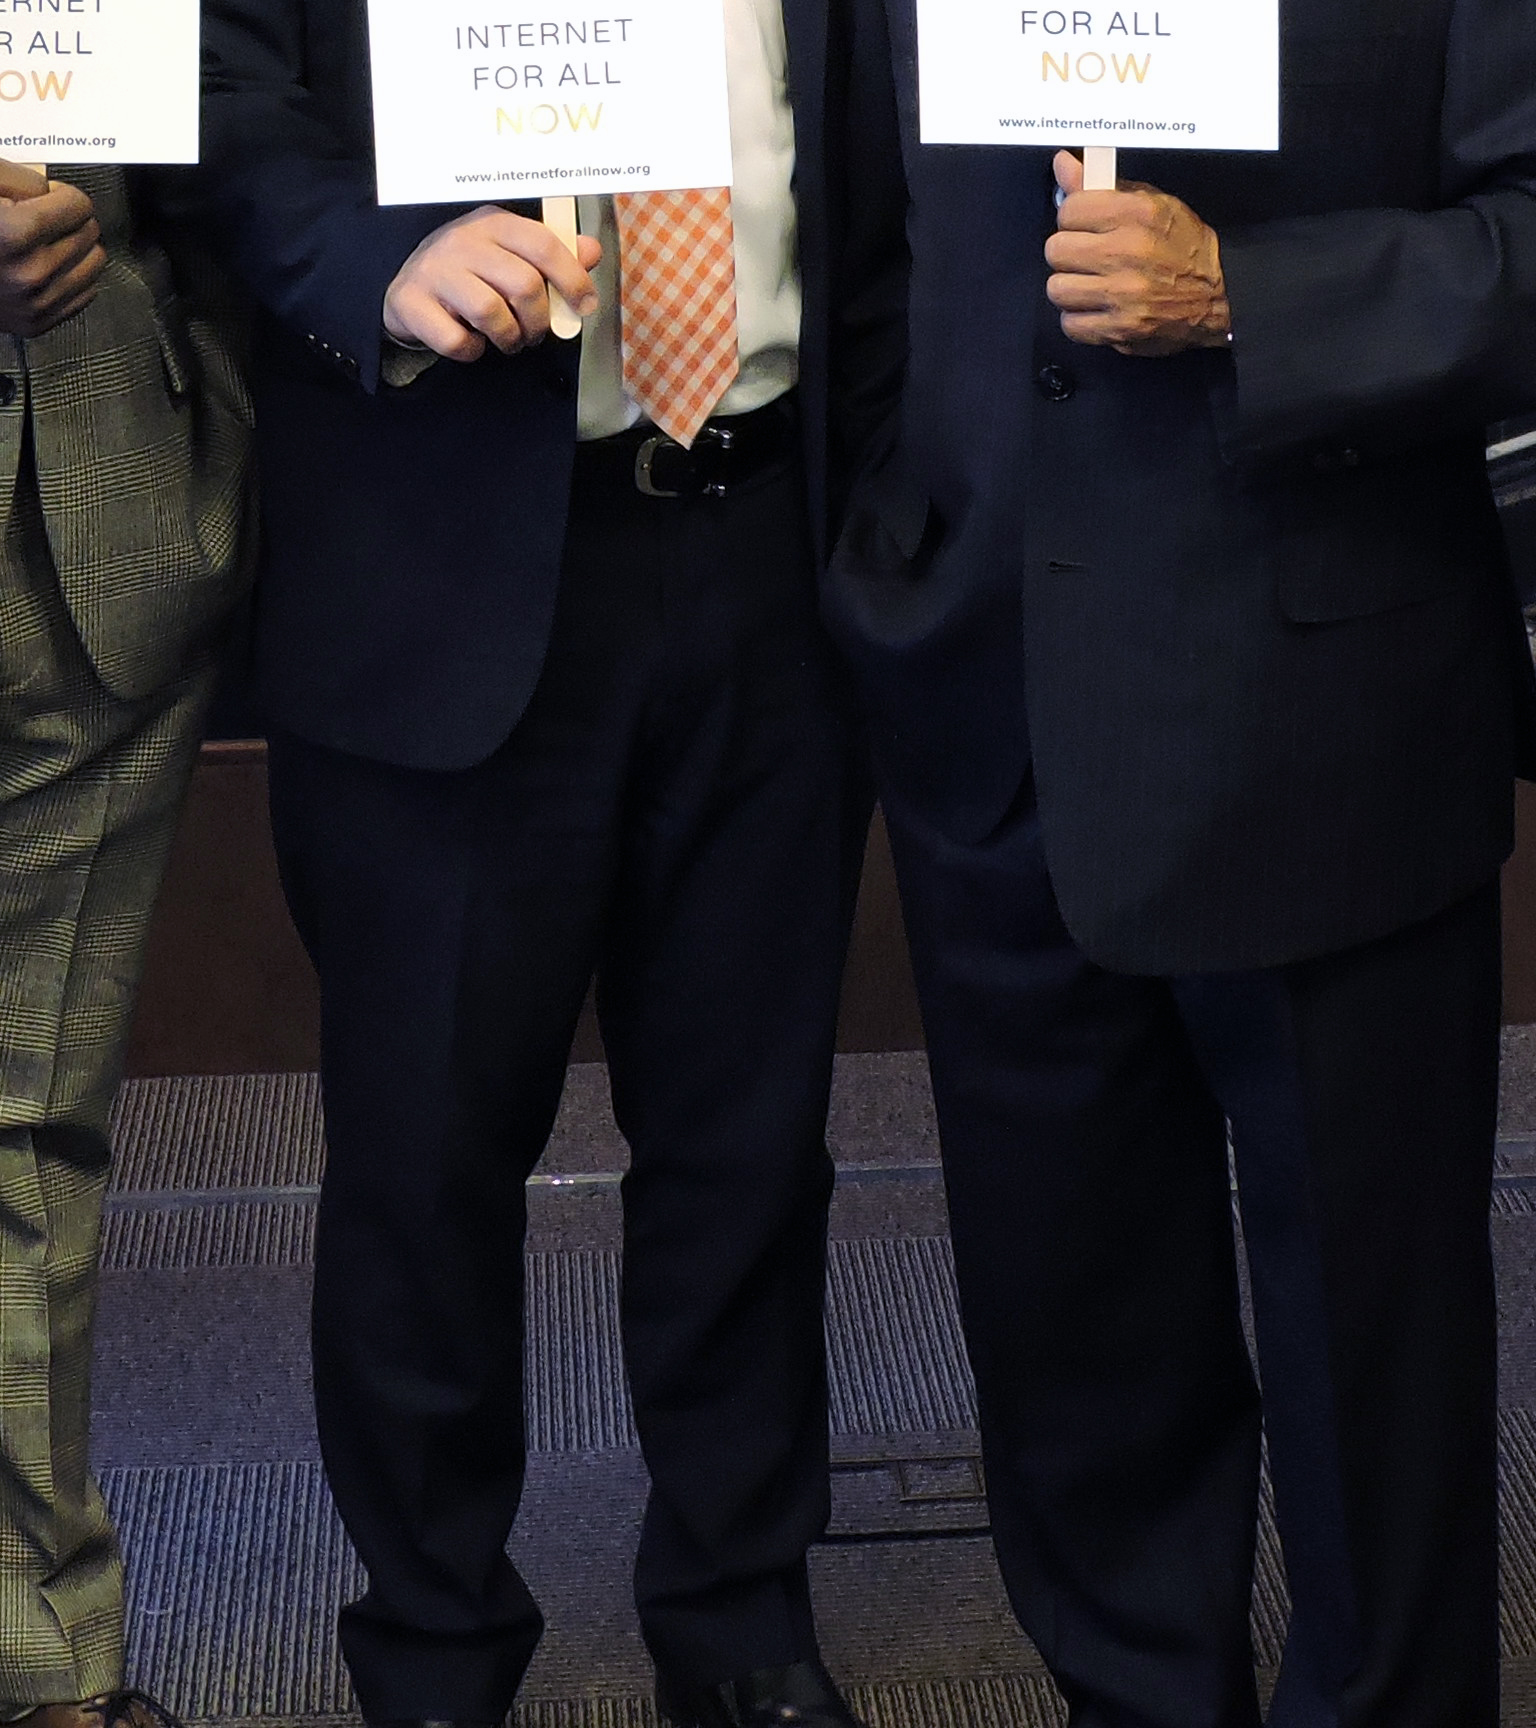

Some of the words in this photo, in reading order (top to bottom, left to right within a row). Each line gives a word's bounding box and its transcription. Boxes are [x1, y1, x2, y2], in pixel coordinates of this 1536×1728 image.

[456, 18, 633, 50] INTERNET
[1021, 10, 1092, 35] FOR
[1106, 11, 1172, 37] ALL
[27, 30, 93, 55] ALL
[473, 64, 544, 91] FOR
[558, 61, 621, 87] ALL
[1041, 50, 1152, 84] NOW
[495, 102, 603, 135] NOW
[998, 117, 1196, 134] www.internetforallnow.org
[455, 165, 651, 183] www.internetforallnow.org
